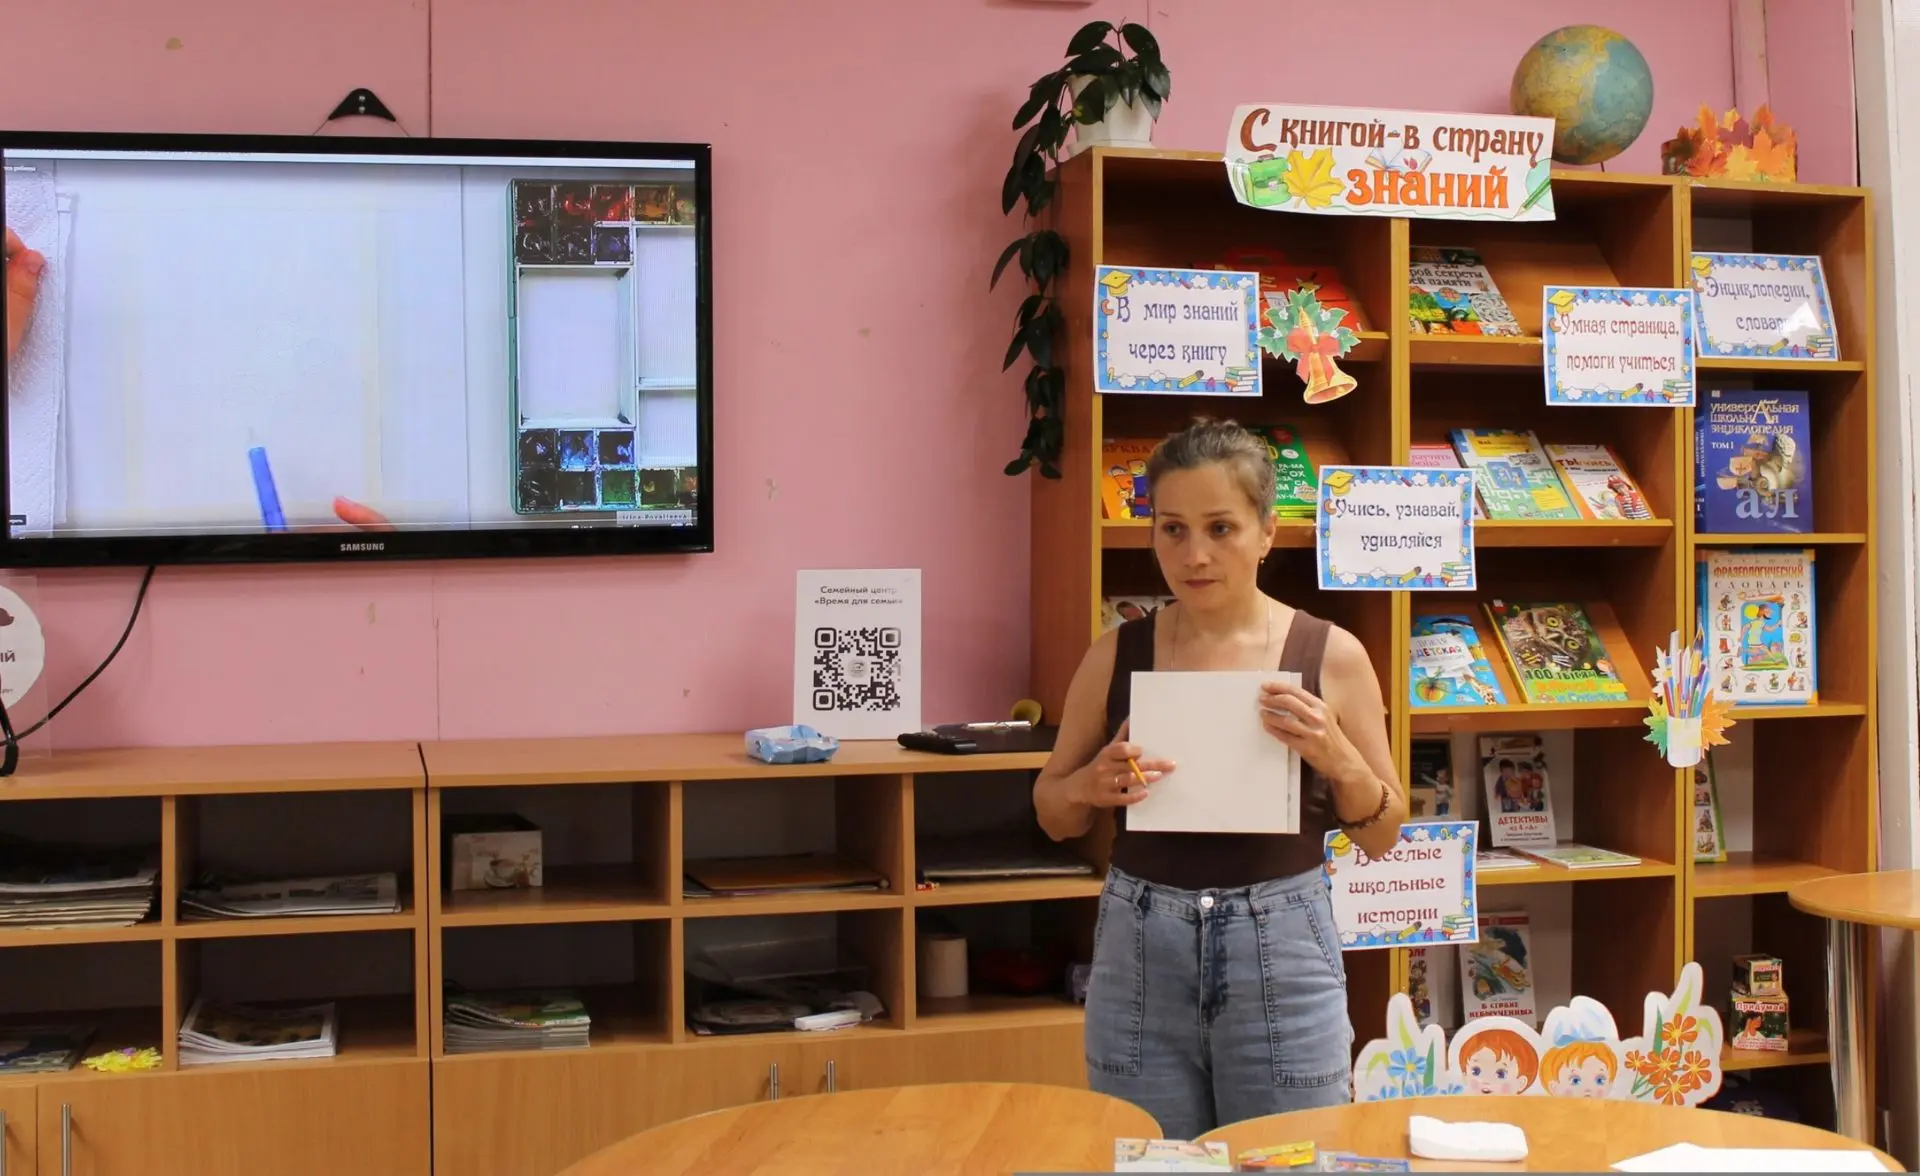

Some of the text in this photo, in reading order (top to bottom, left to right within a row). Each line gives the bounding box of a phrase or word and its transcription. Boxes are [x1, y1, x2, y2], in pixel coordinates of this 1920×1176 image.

[1240, 108, 1277, 151] С
[1433, 126, 1544, 168] страну
[1346, 165, 1509, 208] знаний
[1706, 276, 1810, 302] Энциклопедии,
[1116, 296, 1238, 323] В мир знаний
[1560, 314, 1679, 339] Умная страница,
[1736, 317, 1790, 336] словар
[1129, 343, 1227, 365] через книгу
[1567, 355, 1675, 373] помоги учиться
[1336, 499, 1460, 520] Учись, узнавай,
[340, 543, 385, 551] SAMSUNG
[1361, 532, 1442, 552] удивляйся
[820, 586, 868, 594] Семейный
[851, 598, 868, 606] для
[1497, 815, 1548, 825] ДЕТЕКТИВЫ
[1354, 842, 1442, 867] Вселые
[1349, 878, 1445, 895] школьные
[1358, 908, 1438, 924] истории
